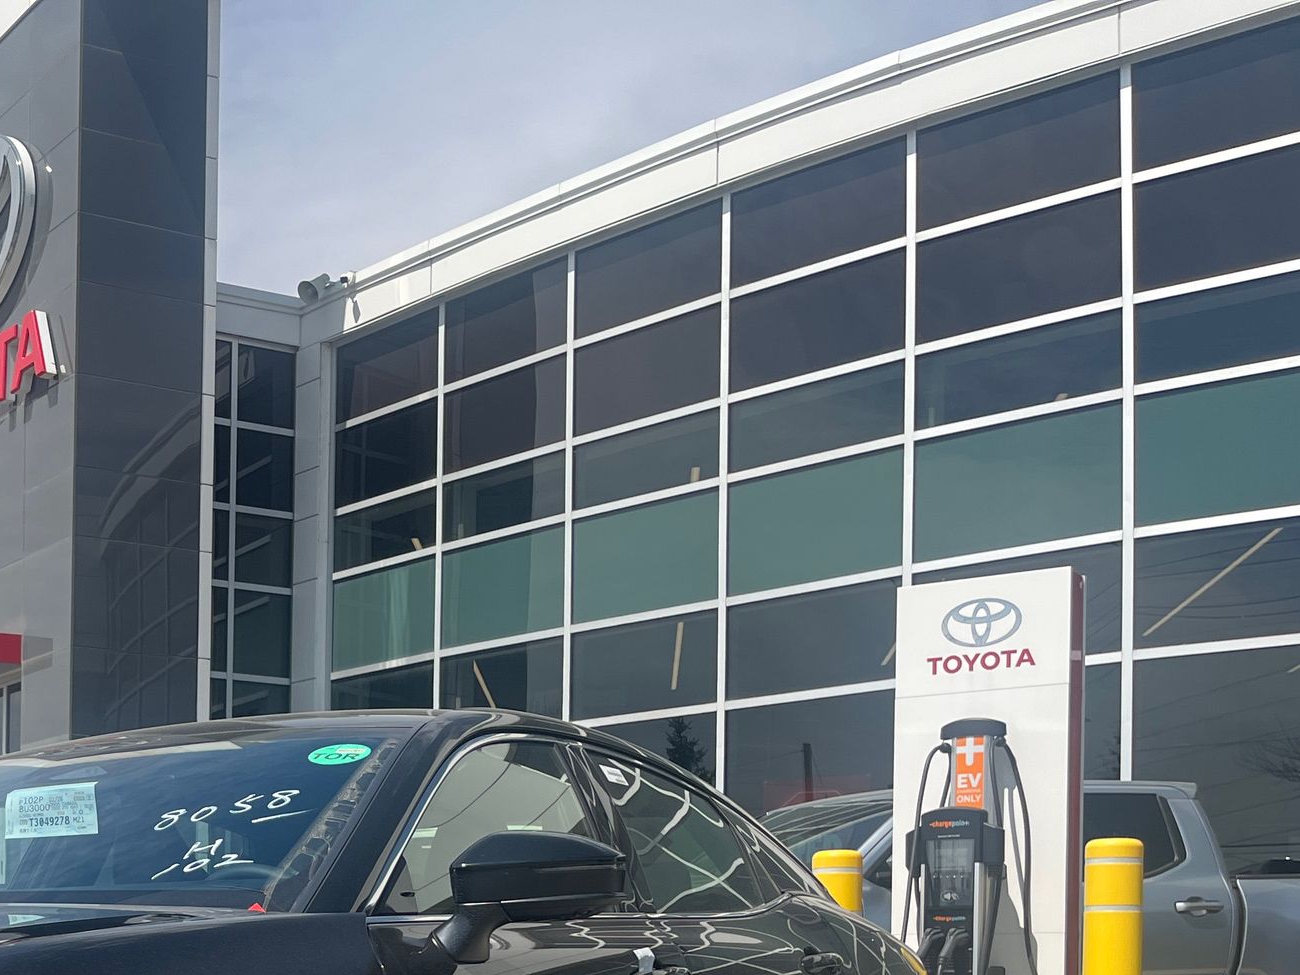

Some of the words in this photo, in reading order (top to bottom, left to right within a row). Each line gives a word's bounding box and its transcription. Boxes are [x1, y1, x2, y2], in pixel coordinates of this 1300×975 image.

[926, 648, 1036, 675] TOYOTA
[313, 752, 360, 760] TOR
[956, 772, 982, 789] EV
[154, 789, 300, 830] 8058
[956, 794, 982, 804] ONLY
[151, 853, 254, 880] 102
